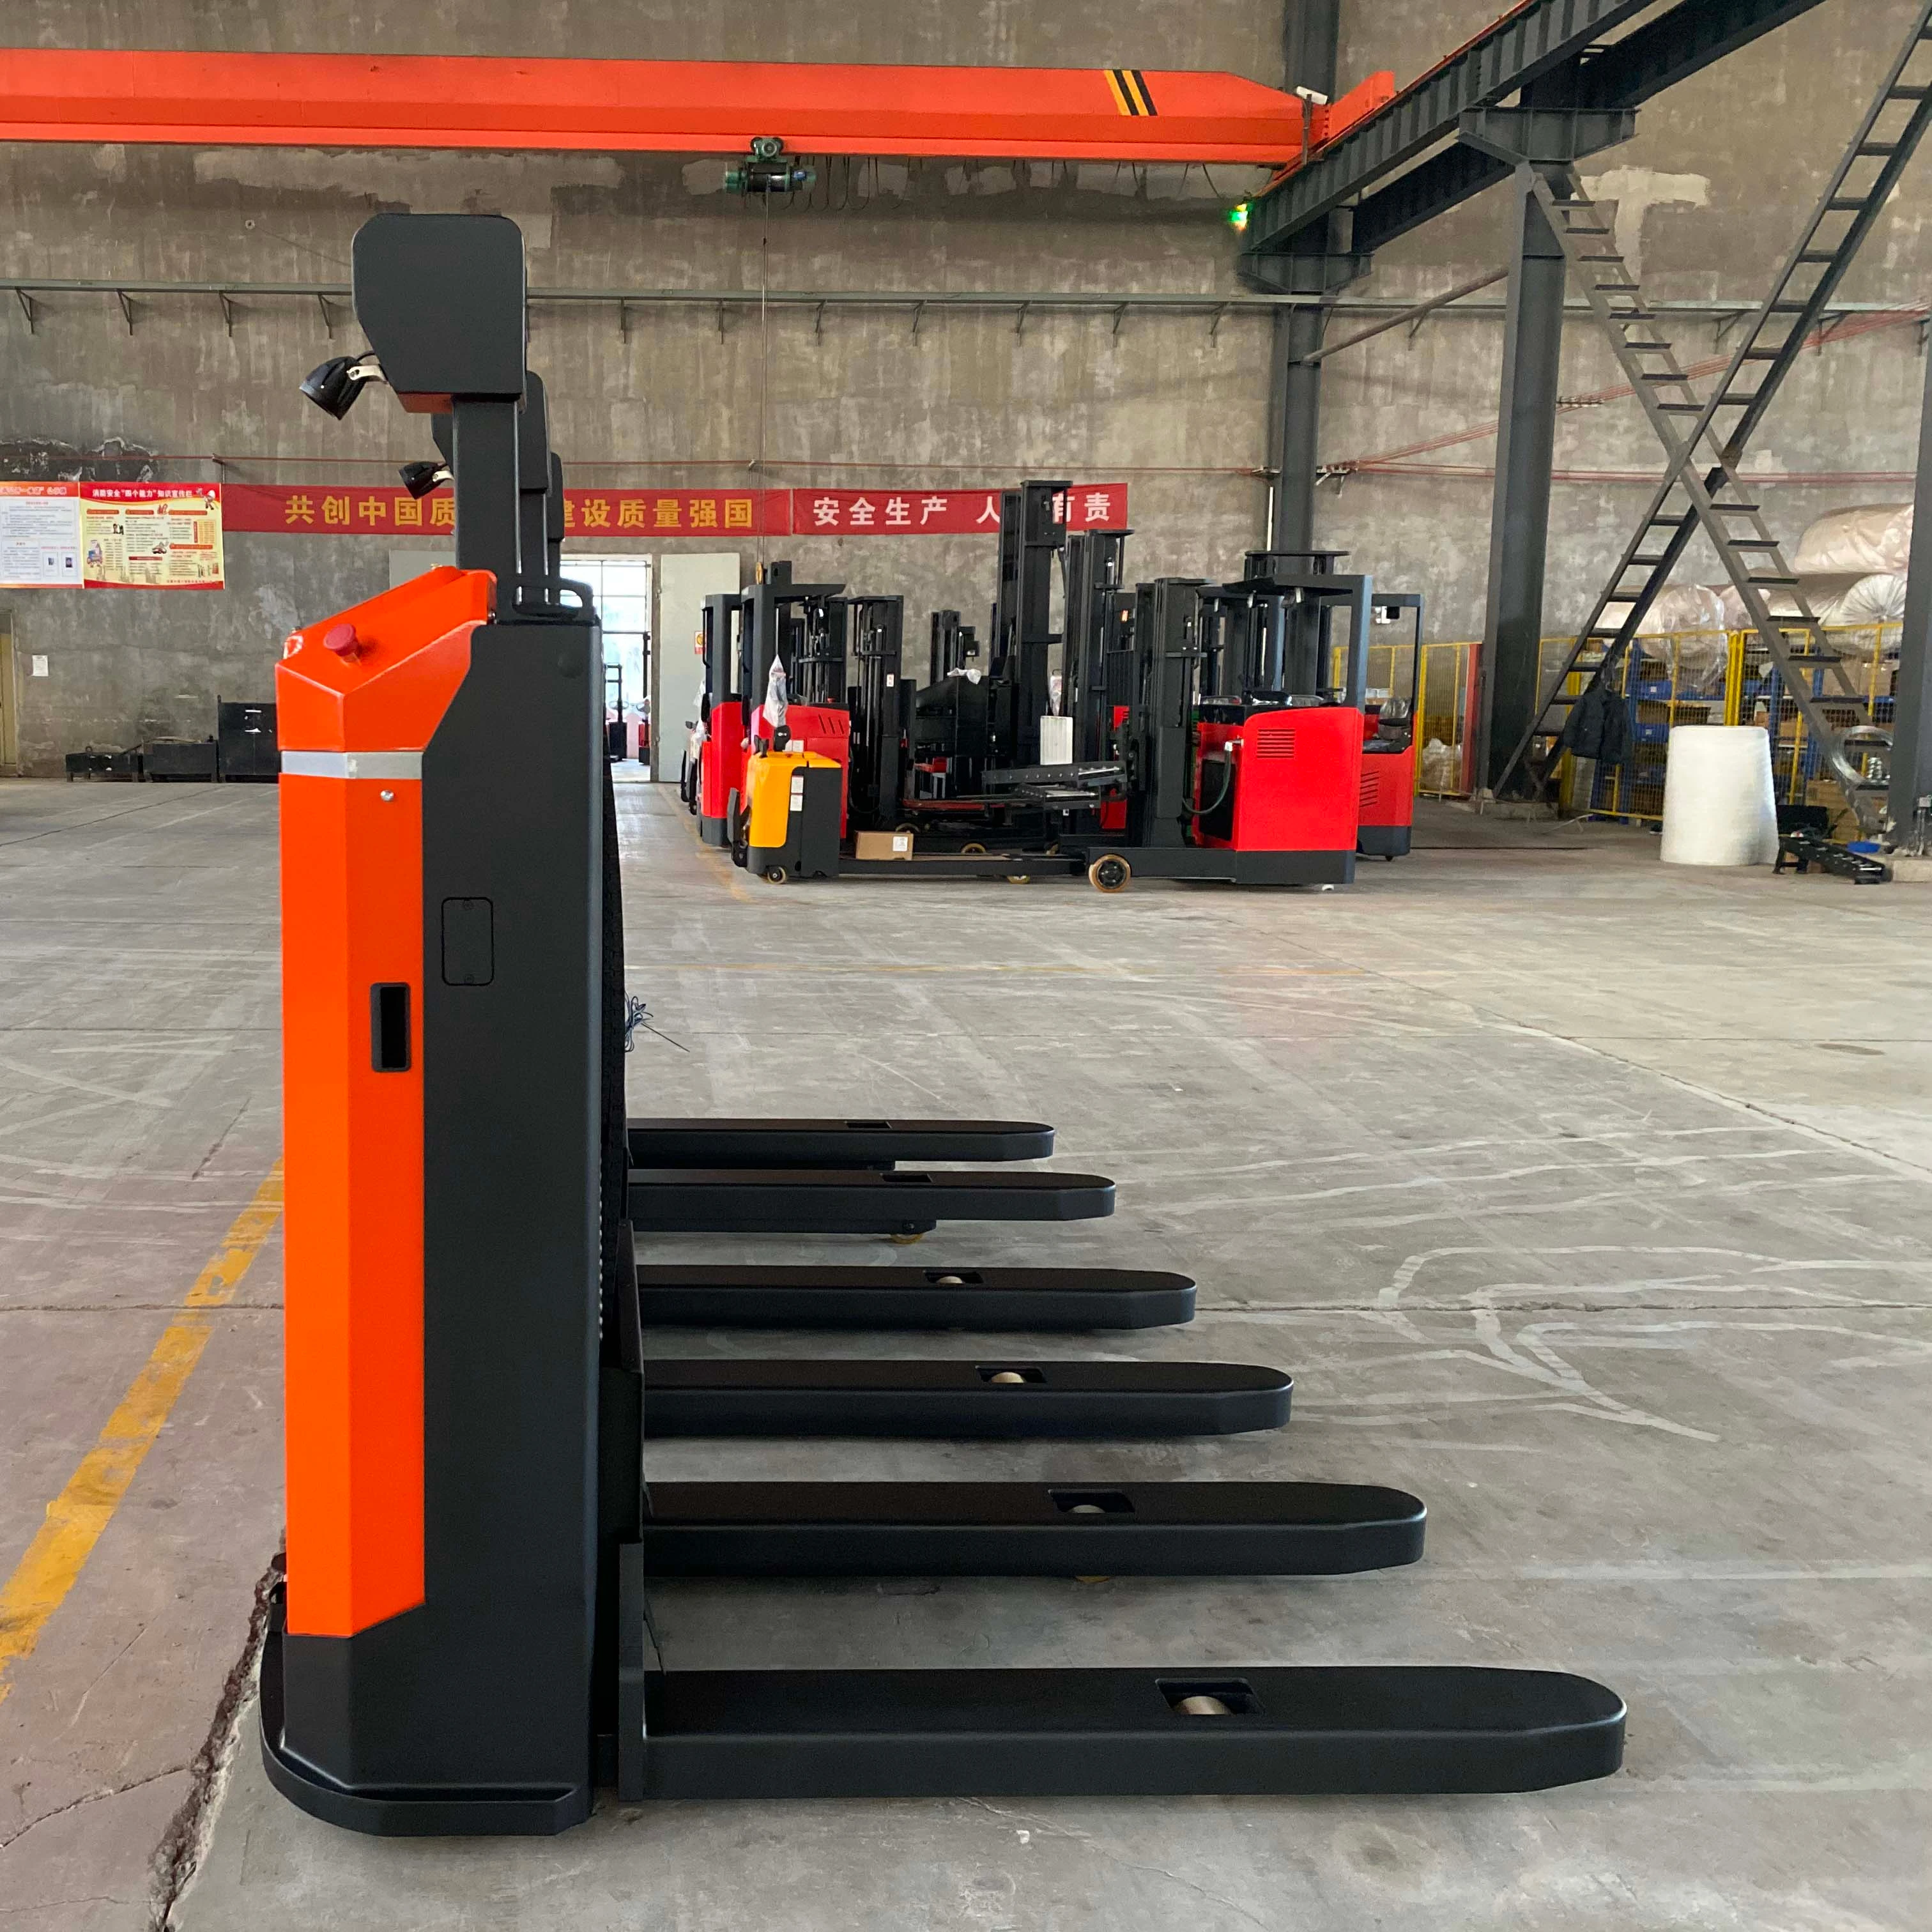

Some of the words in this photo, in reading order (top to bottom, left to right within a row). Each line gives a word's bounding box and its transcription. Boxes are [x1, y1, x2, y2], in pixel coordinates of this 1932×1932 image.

[285, 495, 456, 526] 共创中国质
[813, 496, 947, 526] 安全生产
[976, 492, 1110, 524] 人有责
